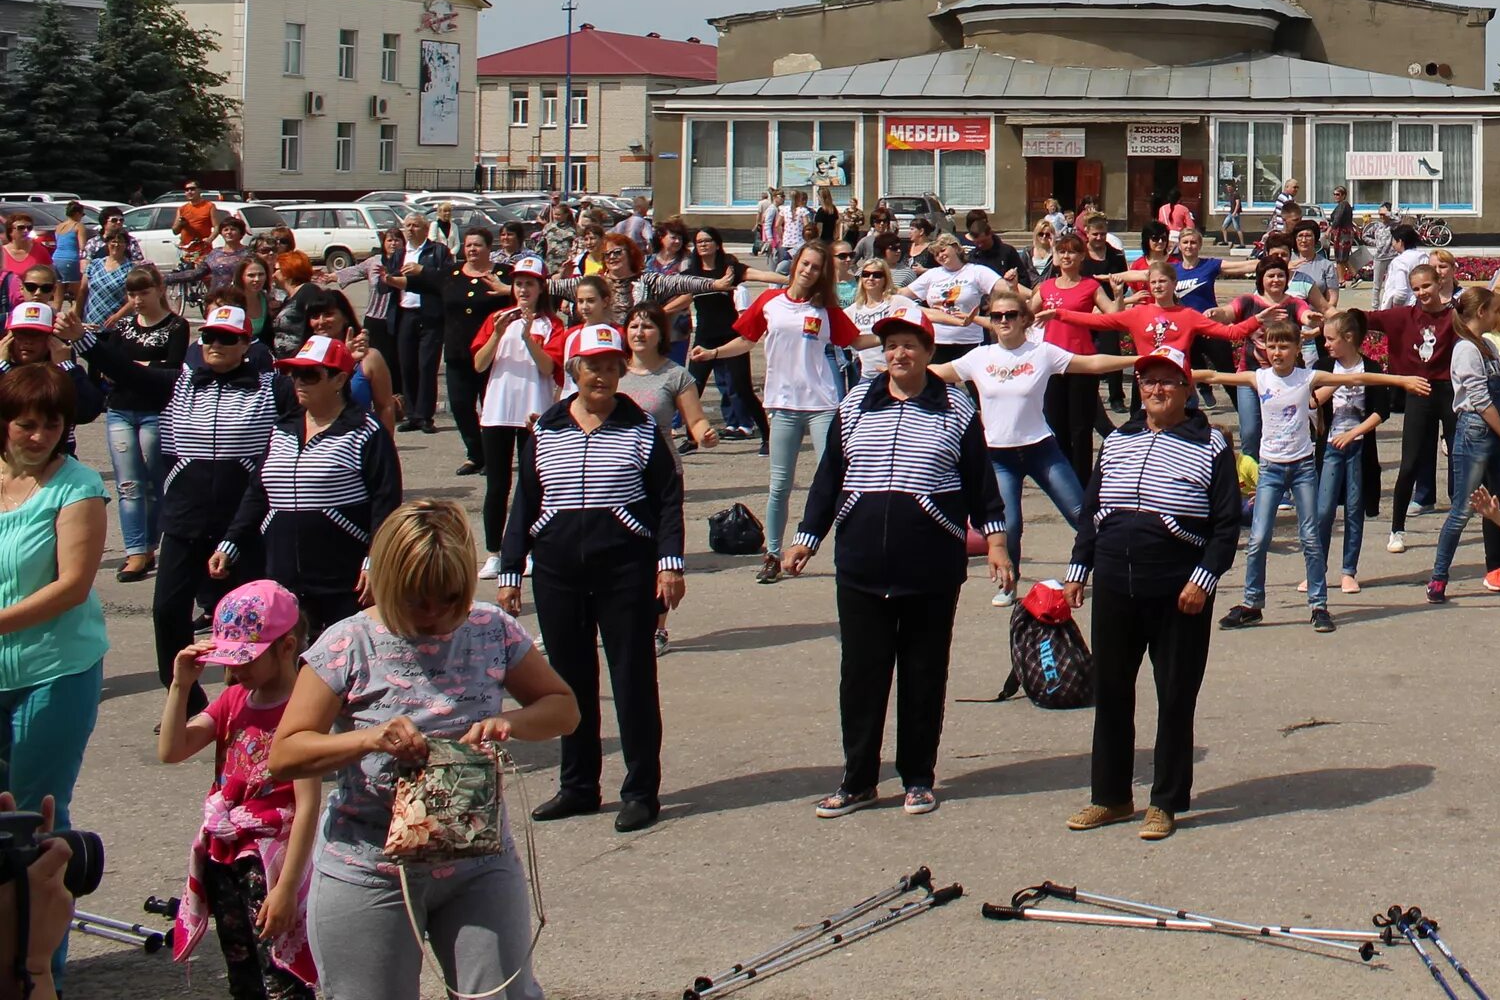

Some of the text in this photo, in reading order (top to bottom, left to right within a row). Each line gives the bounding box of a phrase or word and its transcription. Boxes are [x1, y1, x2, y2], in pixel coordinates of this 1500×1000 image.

[890, 125, 960, 142] МЕБЕЛЬ
[1025, 140, 1081, 155] МЕБЕЛЬ
[1350, 154, 1415, 176] КАБЛУЧОК
[1175, 277, 1199, 291] NIKE
[1040, 639, 1058, 681] NIKE
